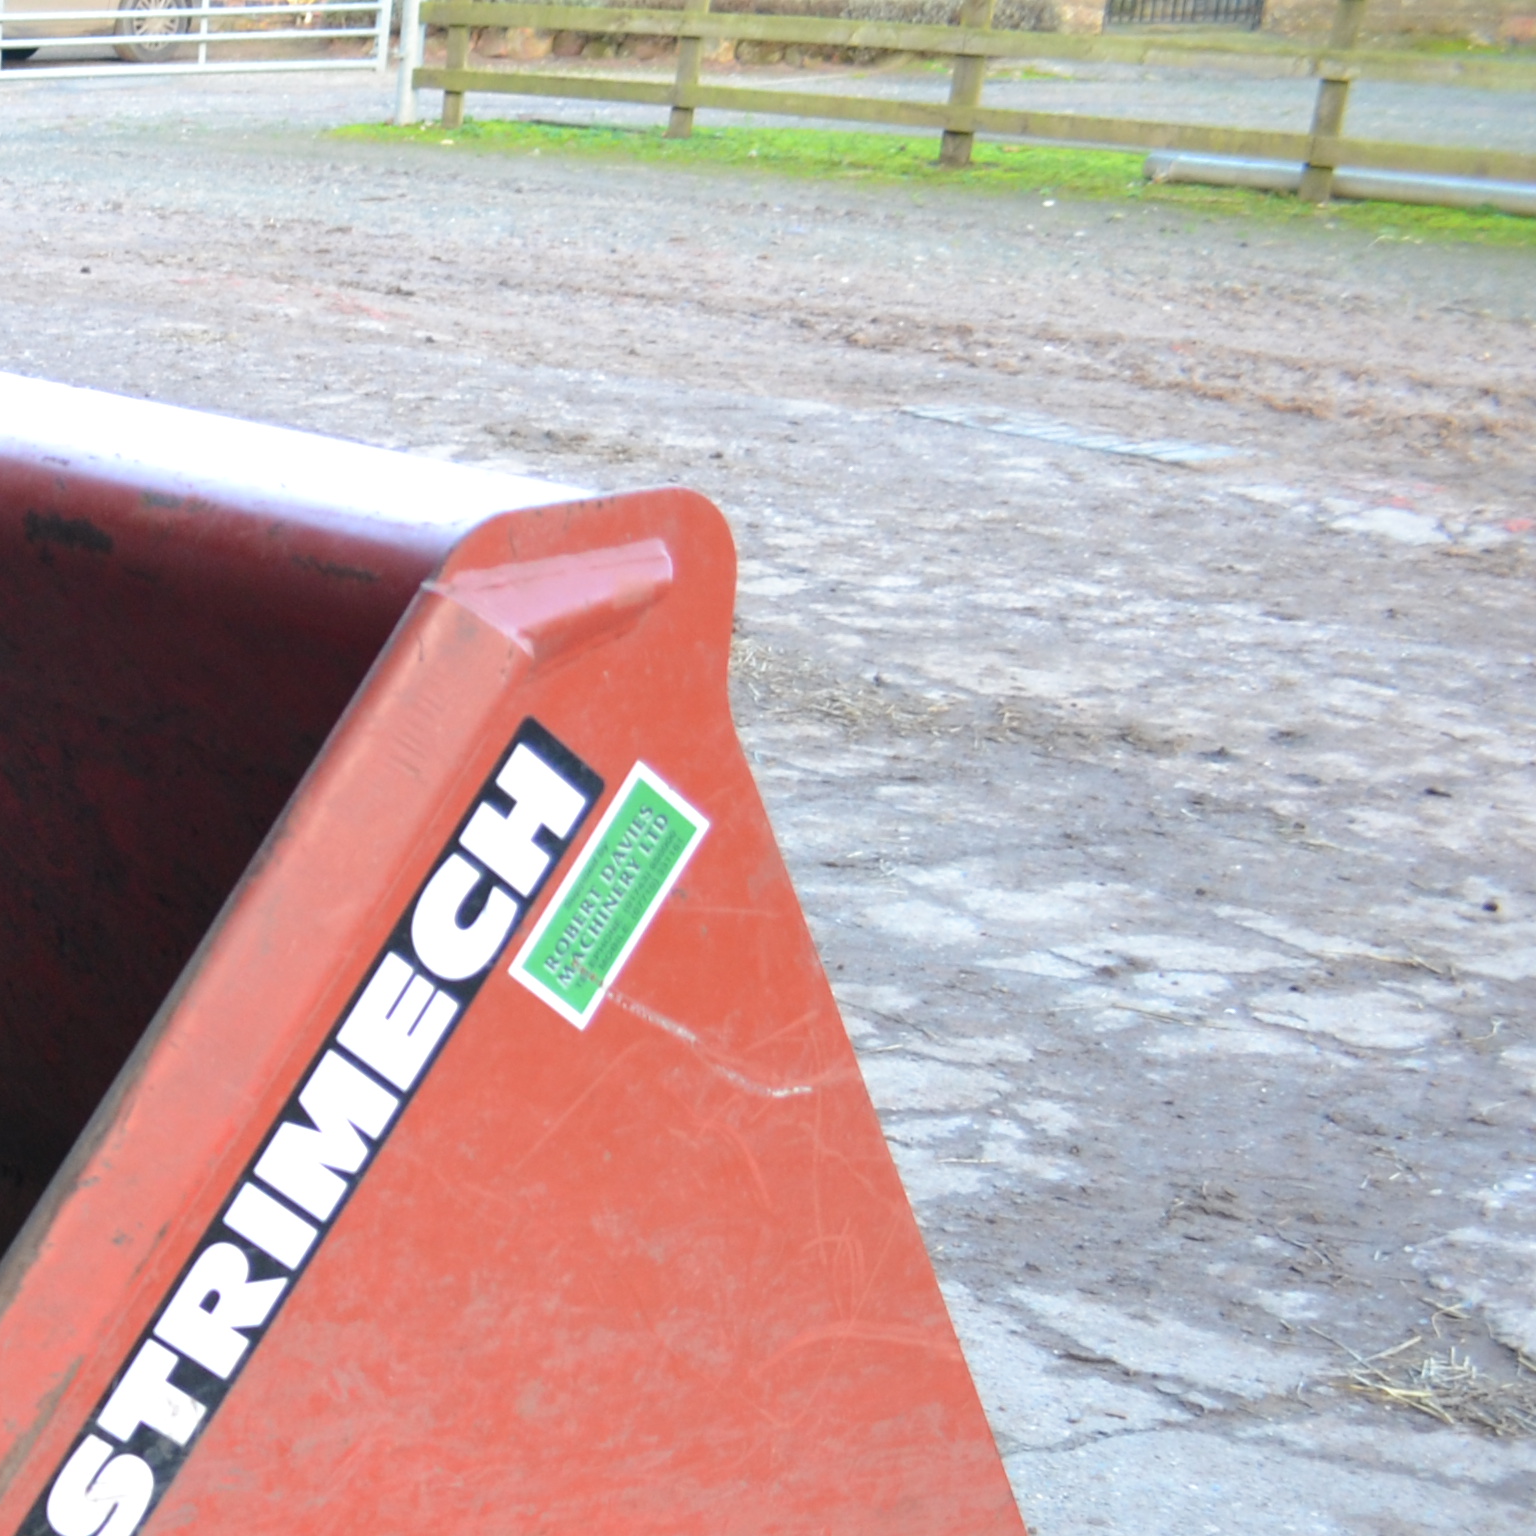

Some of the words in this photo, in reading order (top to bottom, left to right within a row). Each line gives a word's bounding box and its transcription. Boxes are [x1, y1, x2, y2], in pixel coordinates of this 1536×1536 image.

[542, 883, 603, 973] ROBERT
[598, 801, 655, 883] DAVIES
[556, 856, 642, 986] MACHINERY
[638, 810, 670, 855] LTD
[597, 923, 630, 971] MOBILE
